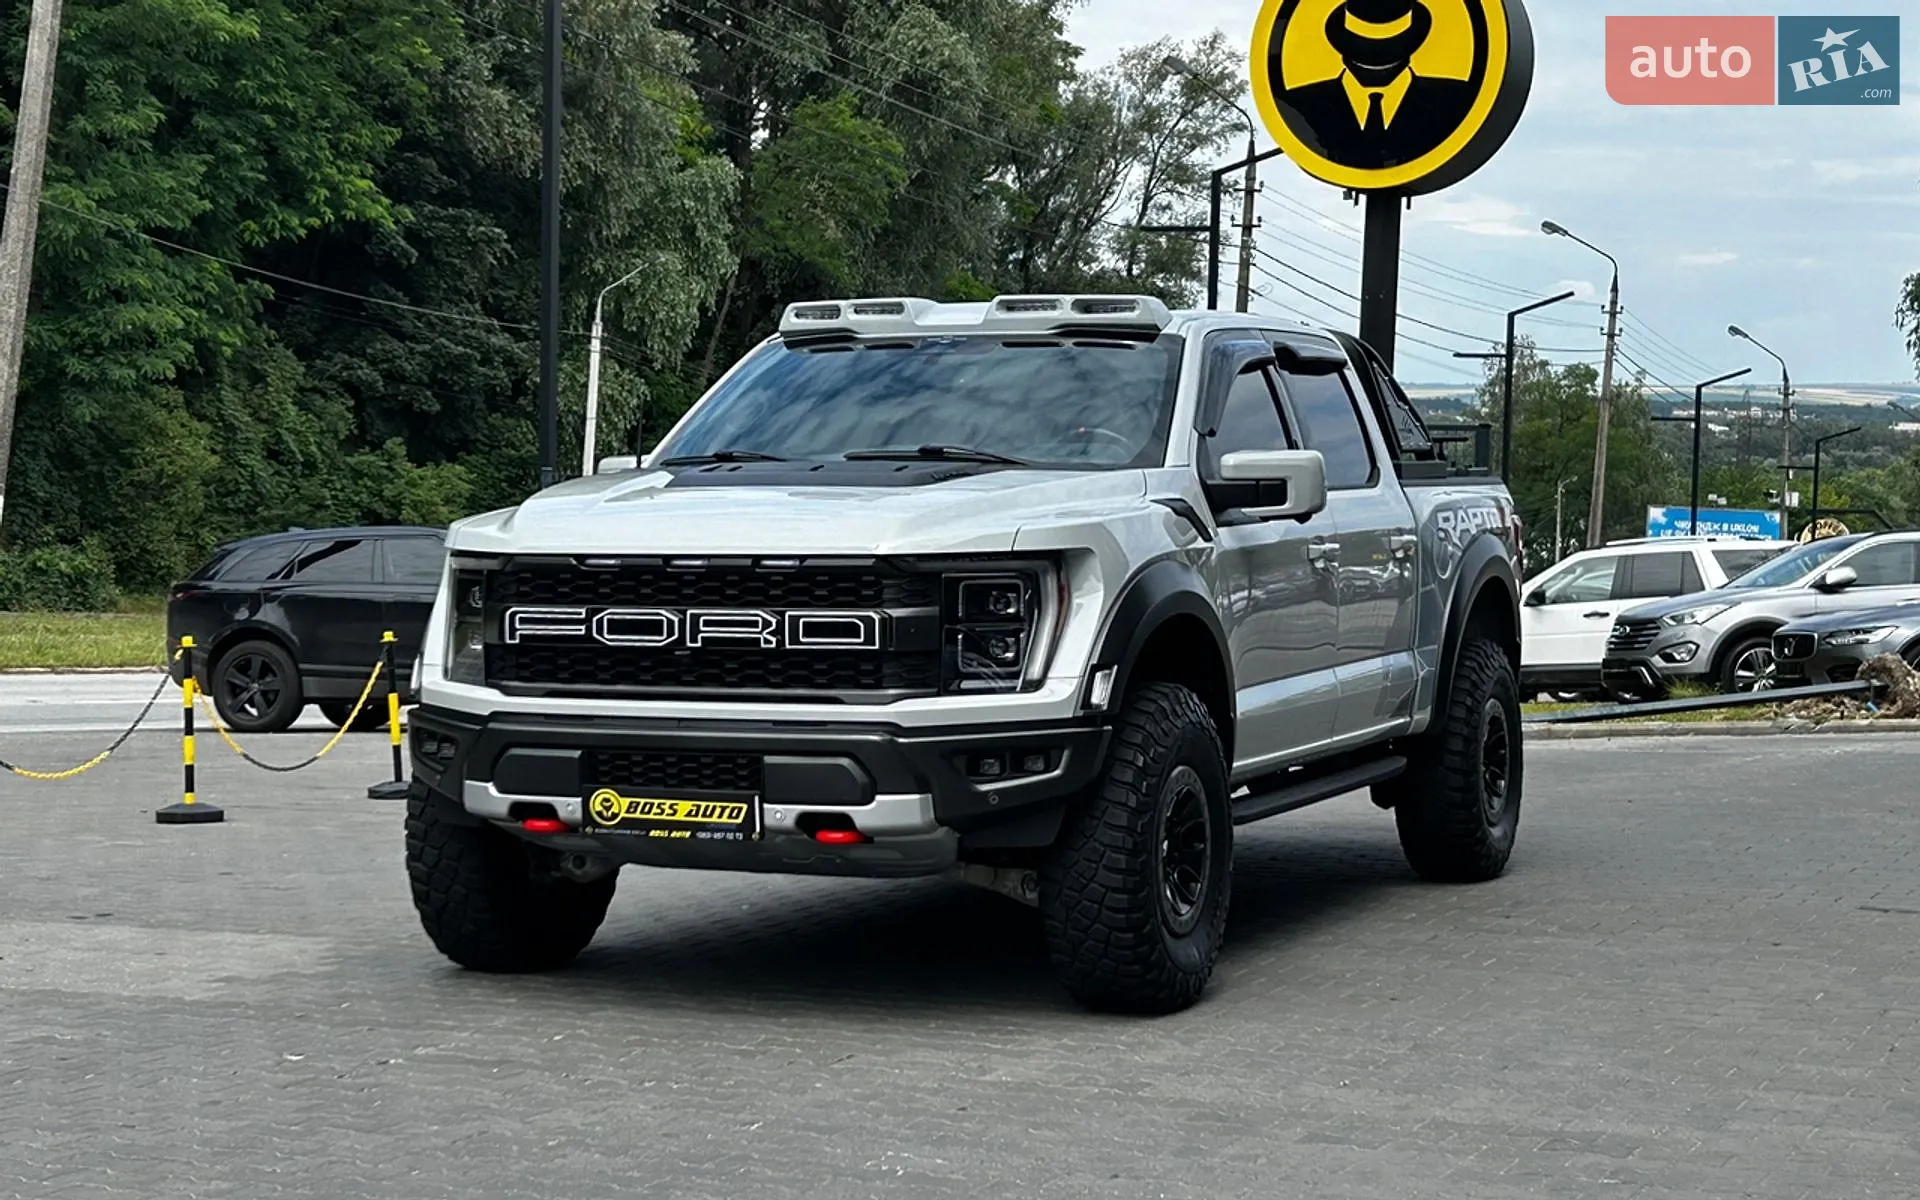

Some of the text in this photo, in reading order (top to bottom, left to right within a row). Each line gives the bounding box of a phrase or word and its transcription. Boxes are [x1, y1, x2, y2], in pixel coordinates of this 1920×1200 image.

[505, 606, 885, 649] FORD
[625, 800, 745, 820] BOSS AUTO
